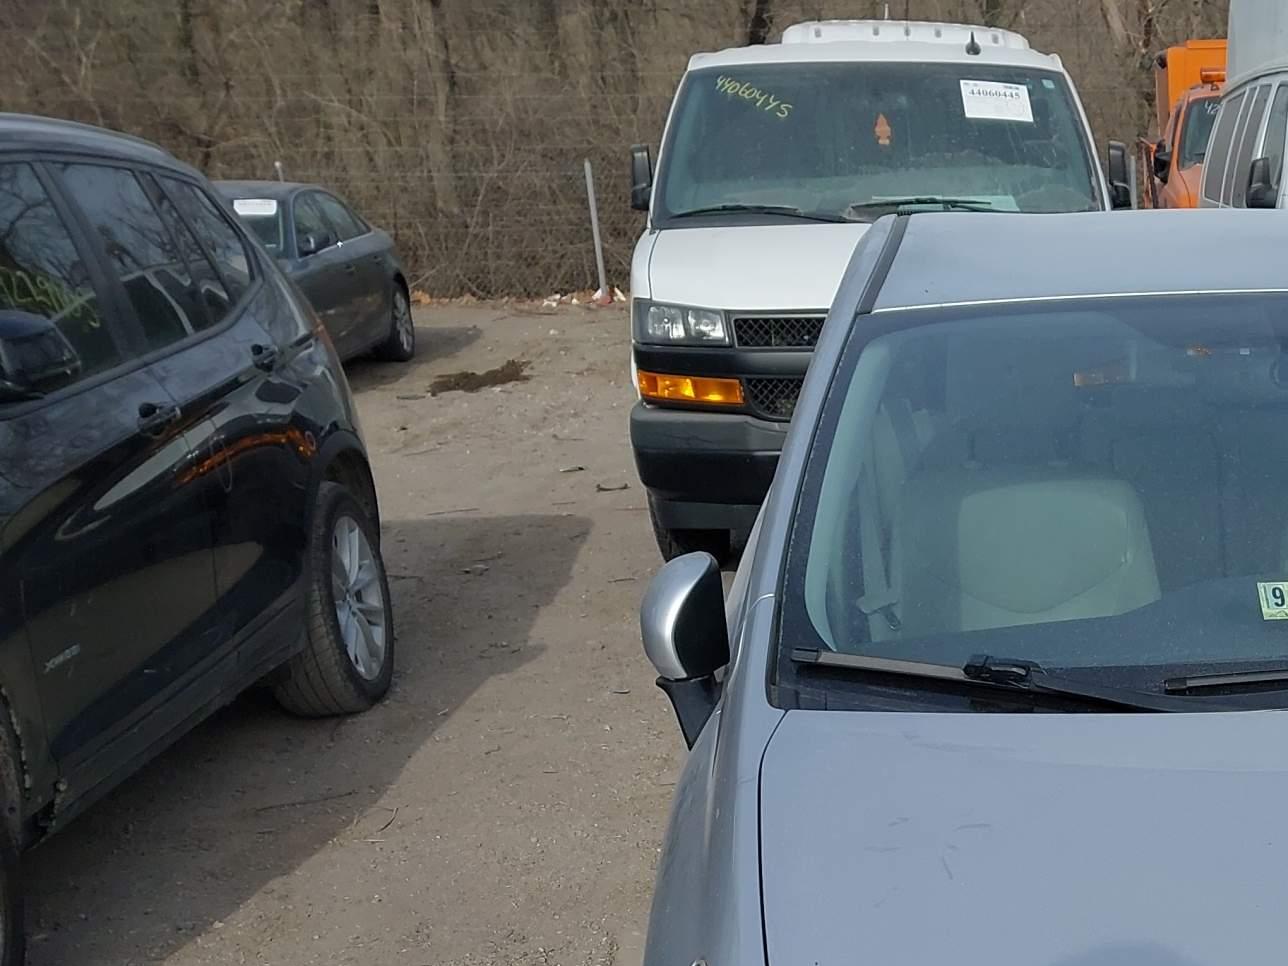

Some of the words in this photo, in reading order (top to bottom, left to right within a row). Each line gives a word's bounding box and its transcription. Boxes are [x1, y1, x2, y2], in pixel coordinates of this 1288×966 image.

[715, 75, 793, 118] 44060445
[968, 88, 1021, 99] 44060445
[1271, 586, 1286, 607] 9
